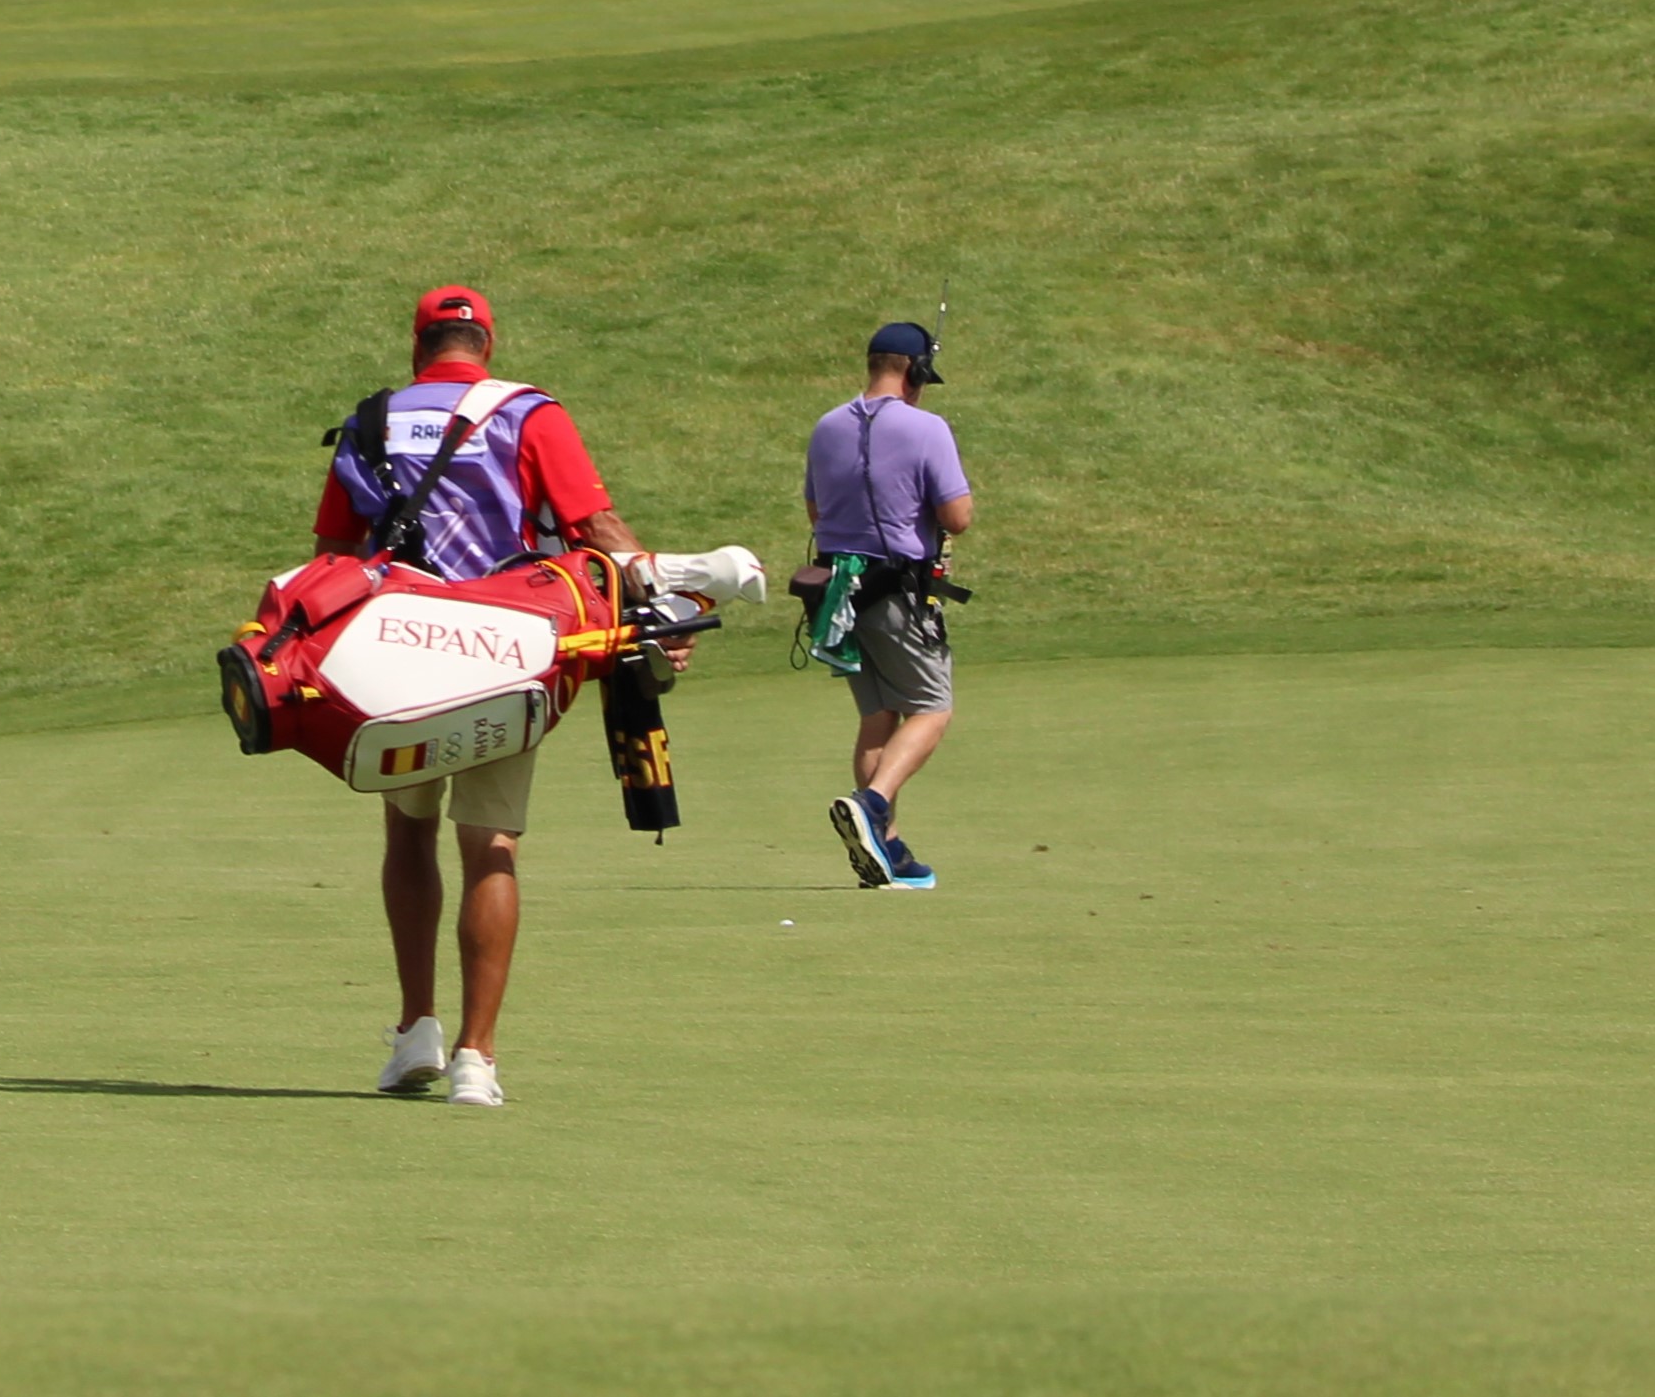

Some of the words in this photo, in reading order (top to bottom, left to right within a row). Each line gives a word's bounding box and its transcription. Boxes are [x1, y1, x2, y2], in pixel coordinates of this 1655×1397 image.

[410, 423, 446, 440] RAH
[377, 616, 527, 670] ESPAÑA
[473, 716, 488, 761] RAHM
[489, 721, 507, 750] JON
